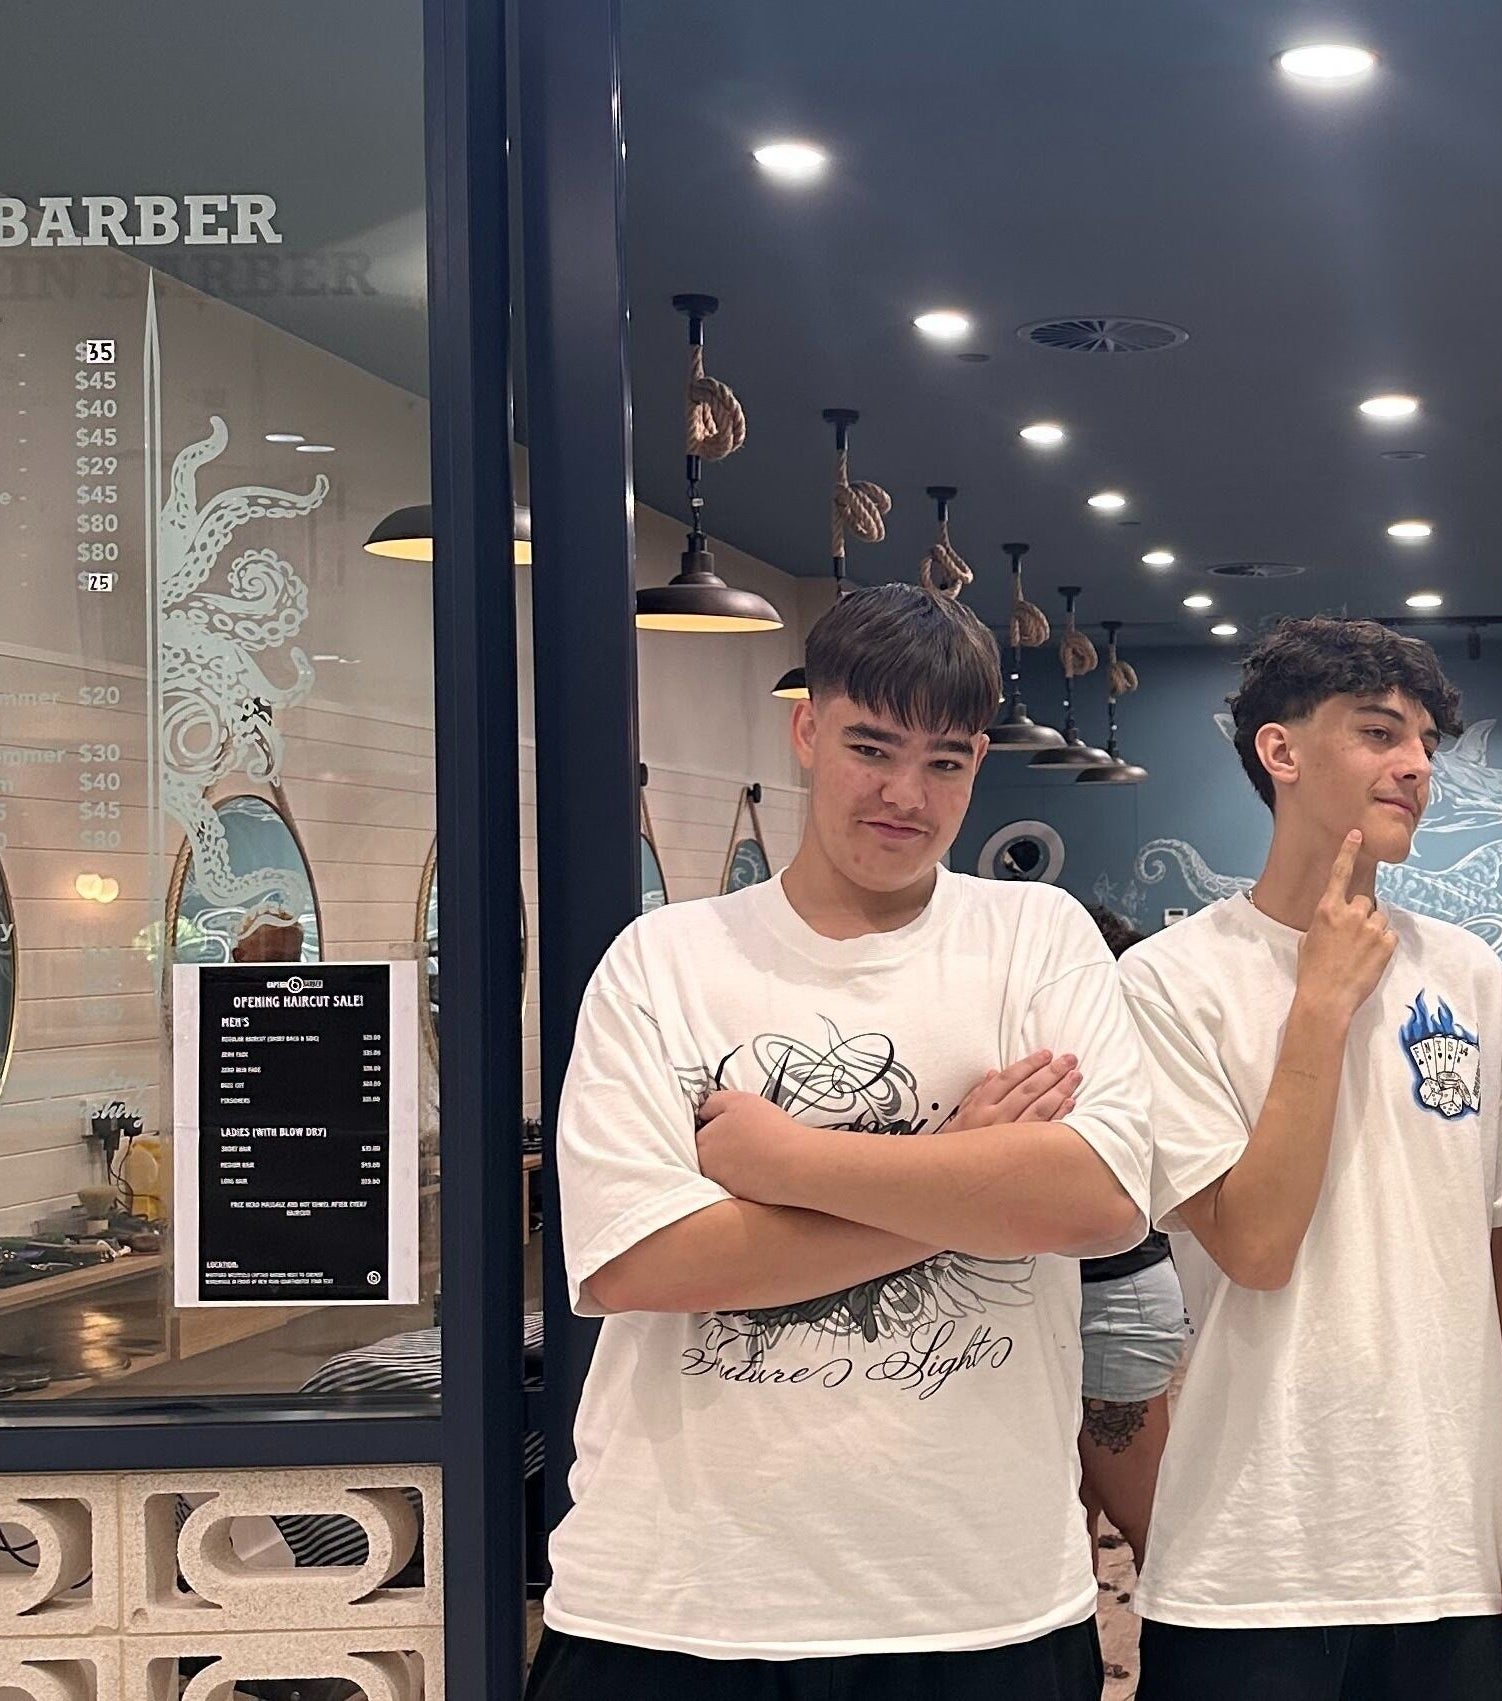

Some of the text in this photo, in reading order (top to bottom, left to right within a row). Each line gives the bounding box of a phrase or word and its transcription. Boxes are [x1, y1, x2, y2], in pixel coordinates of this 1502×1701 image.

[0, 194, 282, 247] BARBER
[75, 370, 117, 390] $45
[75, 399, 117, 419] $40
[76, 427, 117, 447] $45
[77, 456, 118, 476] $29
[77, 485, 117, 504] $45
[77, 514, 118, 533] $80
[78, 542, 118, 562] $80
[79, 686, 120, 705] $20
[79, 744, 120, 763] $30
[79, 772, 120, 792] $40
[79, 800, 120, 820] $45
[80, 830, 121, 849] $80
[233, 994, 364, 1009] OPENING HAIRCUT SALE!
[221, 1017, 250, 1028] MEN'S
[221, 1127, 327, 1138] LADIES (WITH BLOW DRY)
